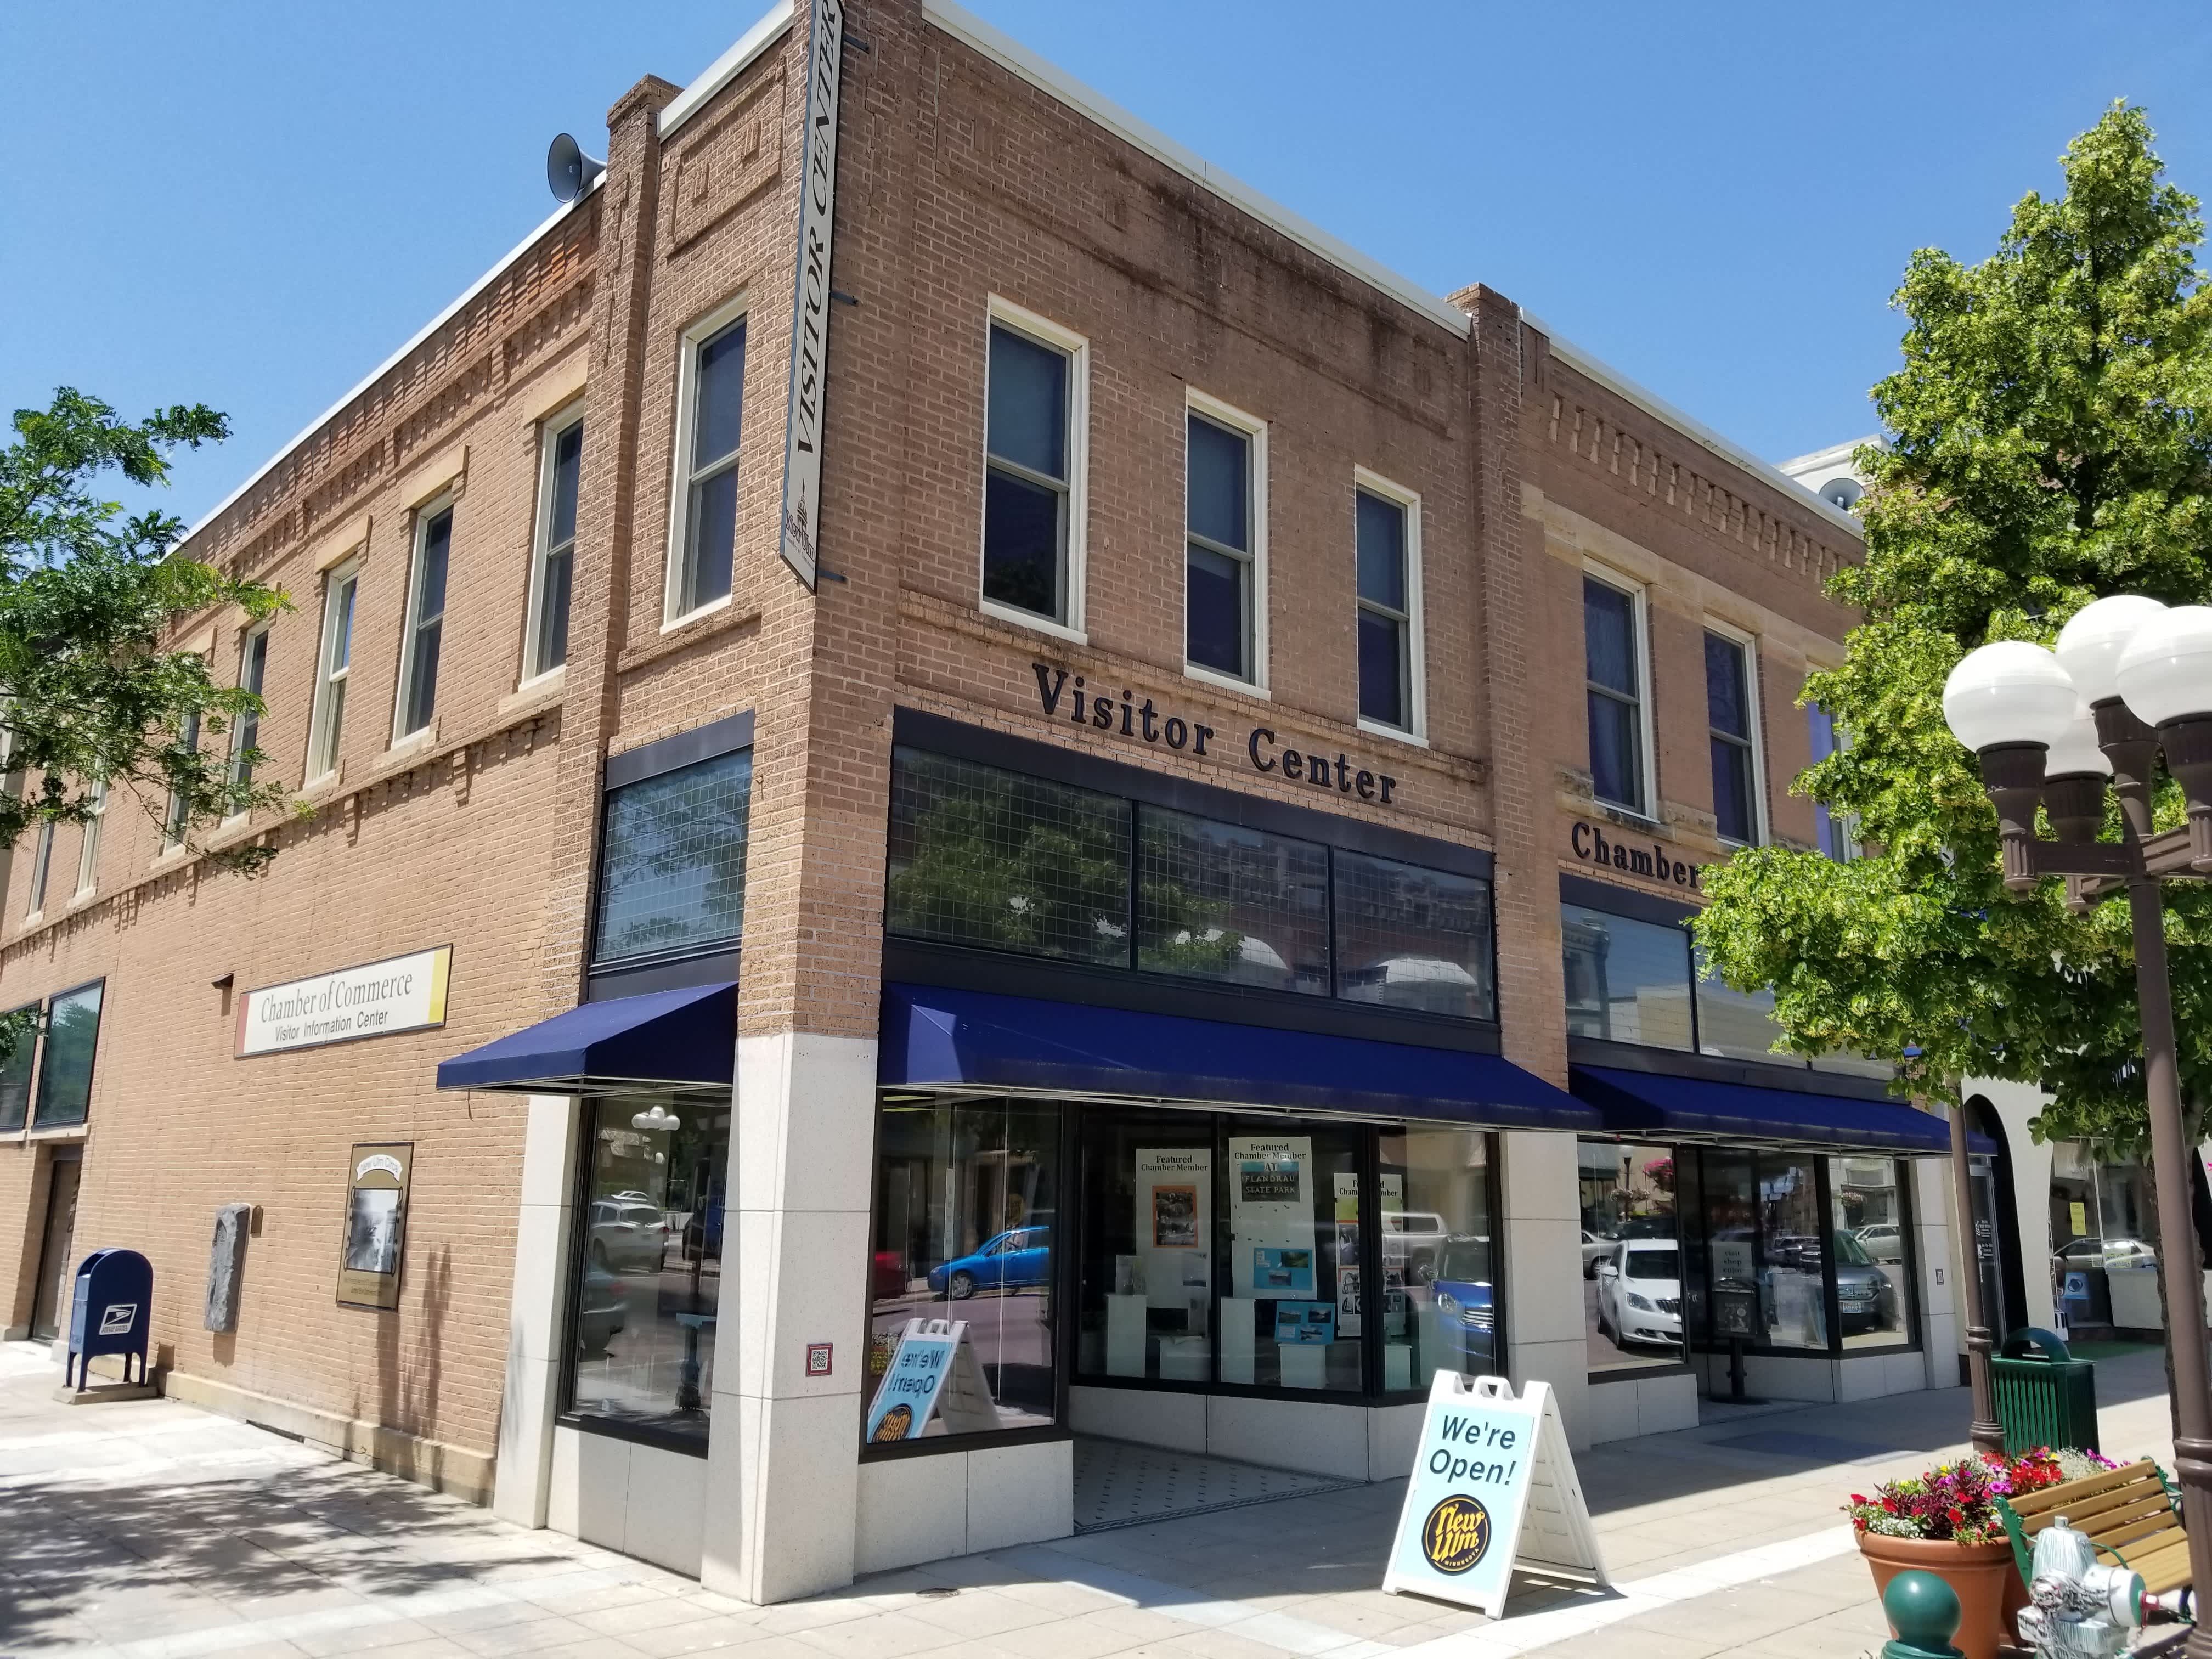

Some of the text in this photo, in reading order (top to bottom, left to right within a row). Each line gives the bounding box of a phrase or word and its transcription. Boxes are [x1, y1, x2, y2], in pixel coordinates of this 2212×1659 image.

[798, 0, 836, 454] VISITOR CENTER
[786, 510, 815, 562] New Ulm
[1032, 662, 1397, 804] Visitor Center
[1571, 822, 1700, 889] Chamber
[261, 973, 413, 1024] Chamber of Commerce
[275, 1009, 389, 1042] Visitor Information Center
[1156, 1155, 1192, 1164] Featured
[1442, 1415, 1516, 1450] We're
[1430, 1449, 1517, 1486] Open!
[1435, 1503, 1486, 1537] New
[1431, 1529, 1480, 1563] Ulm
